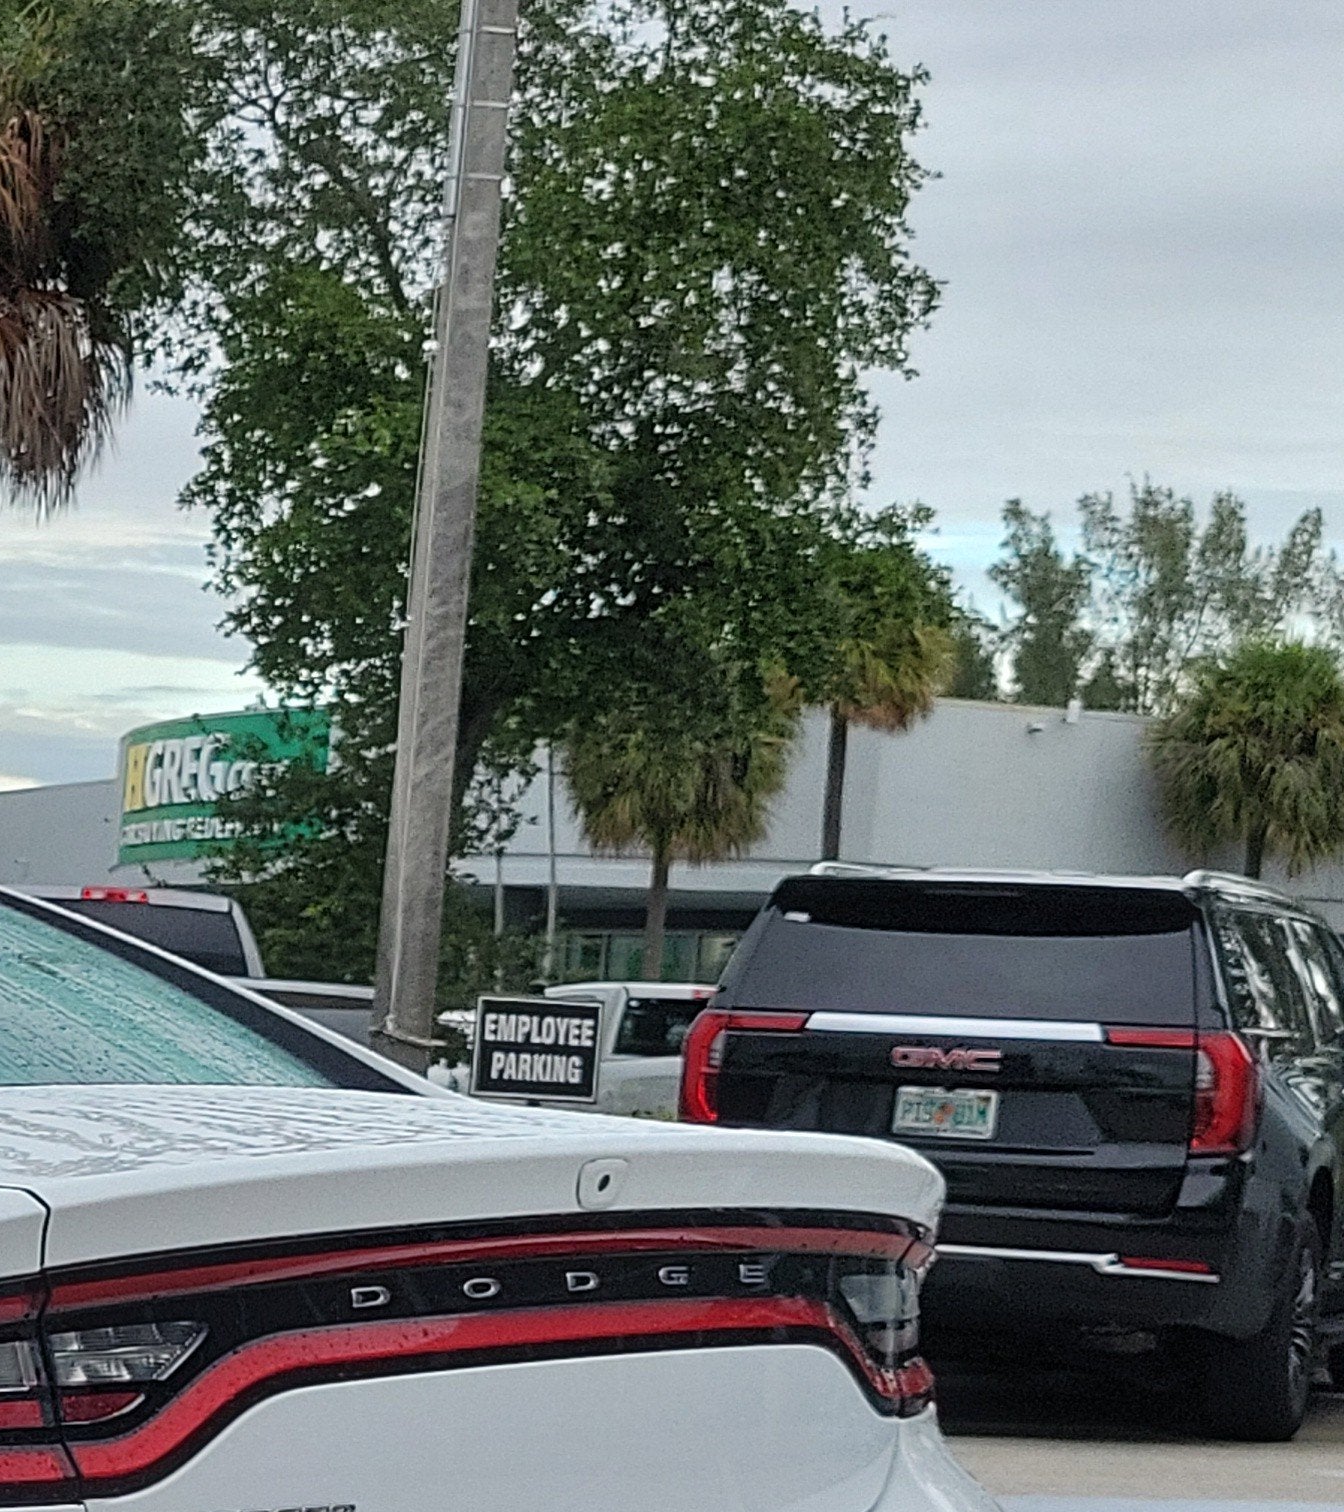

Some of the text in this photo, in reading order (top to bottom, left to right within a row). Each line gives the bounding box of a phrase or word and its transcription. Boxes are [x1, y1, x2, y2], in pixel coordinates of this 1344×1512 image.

[483, 1013, 596, 1048] EMPLOYEE
[490, 1051, 584, 1084] PARKING
[890, 1045, 1002, 1072] GMC
[350, 1262, 769, 1309] DODGE
